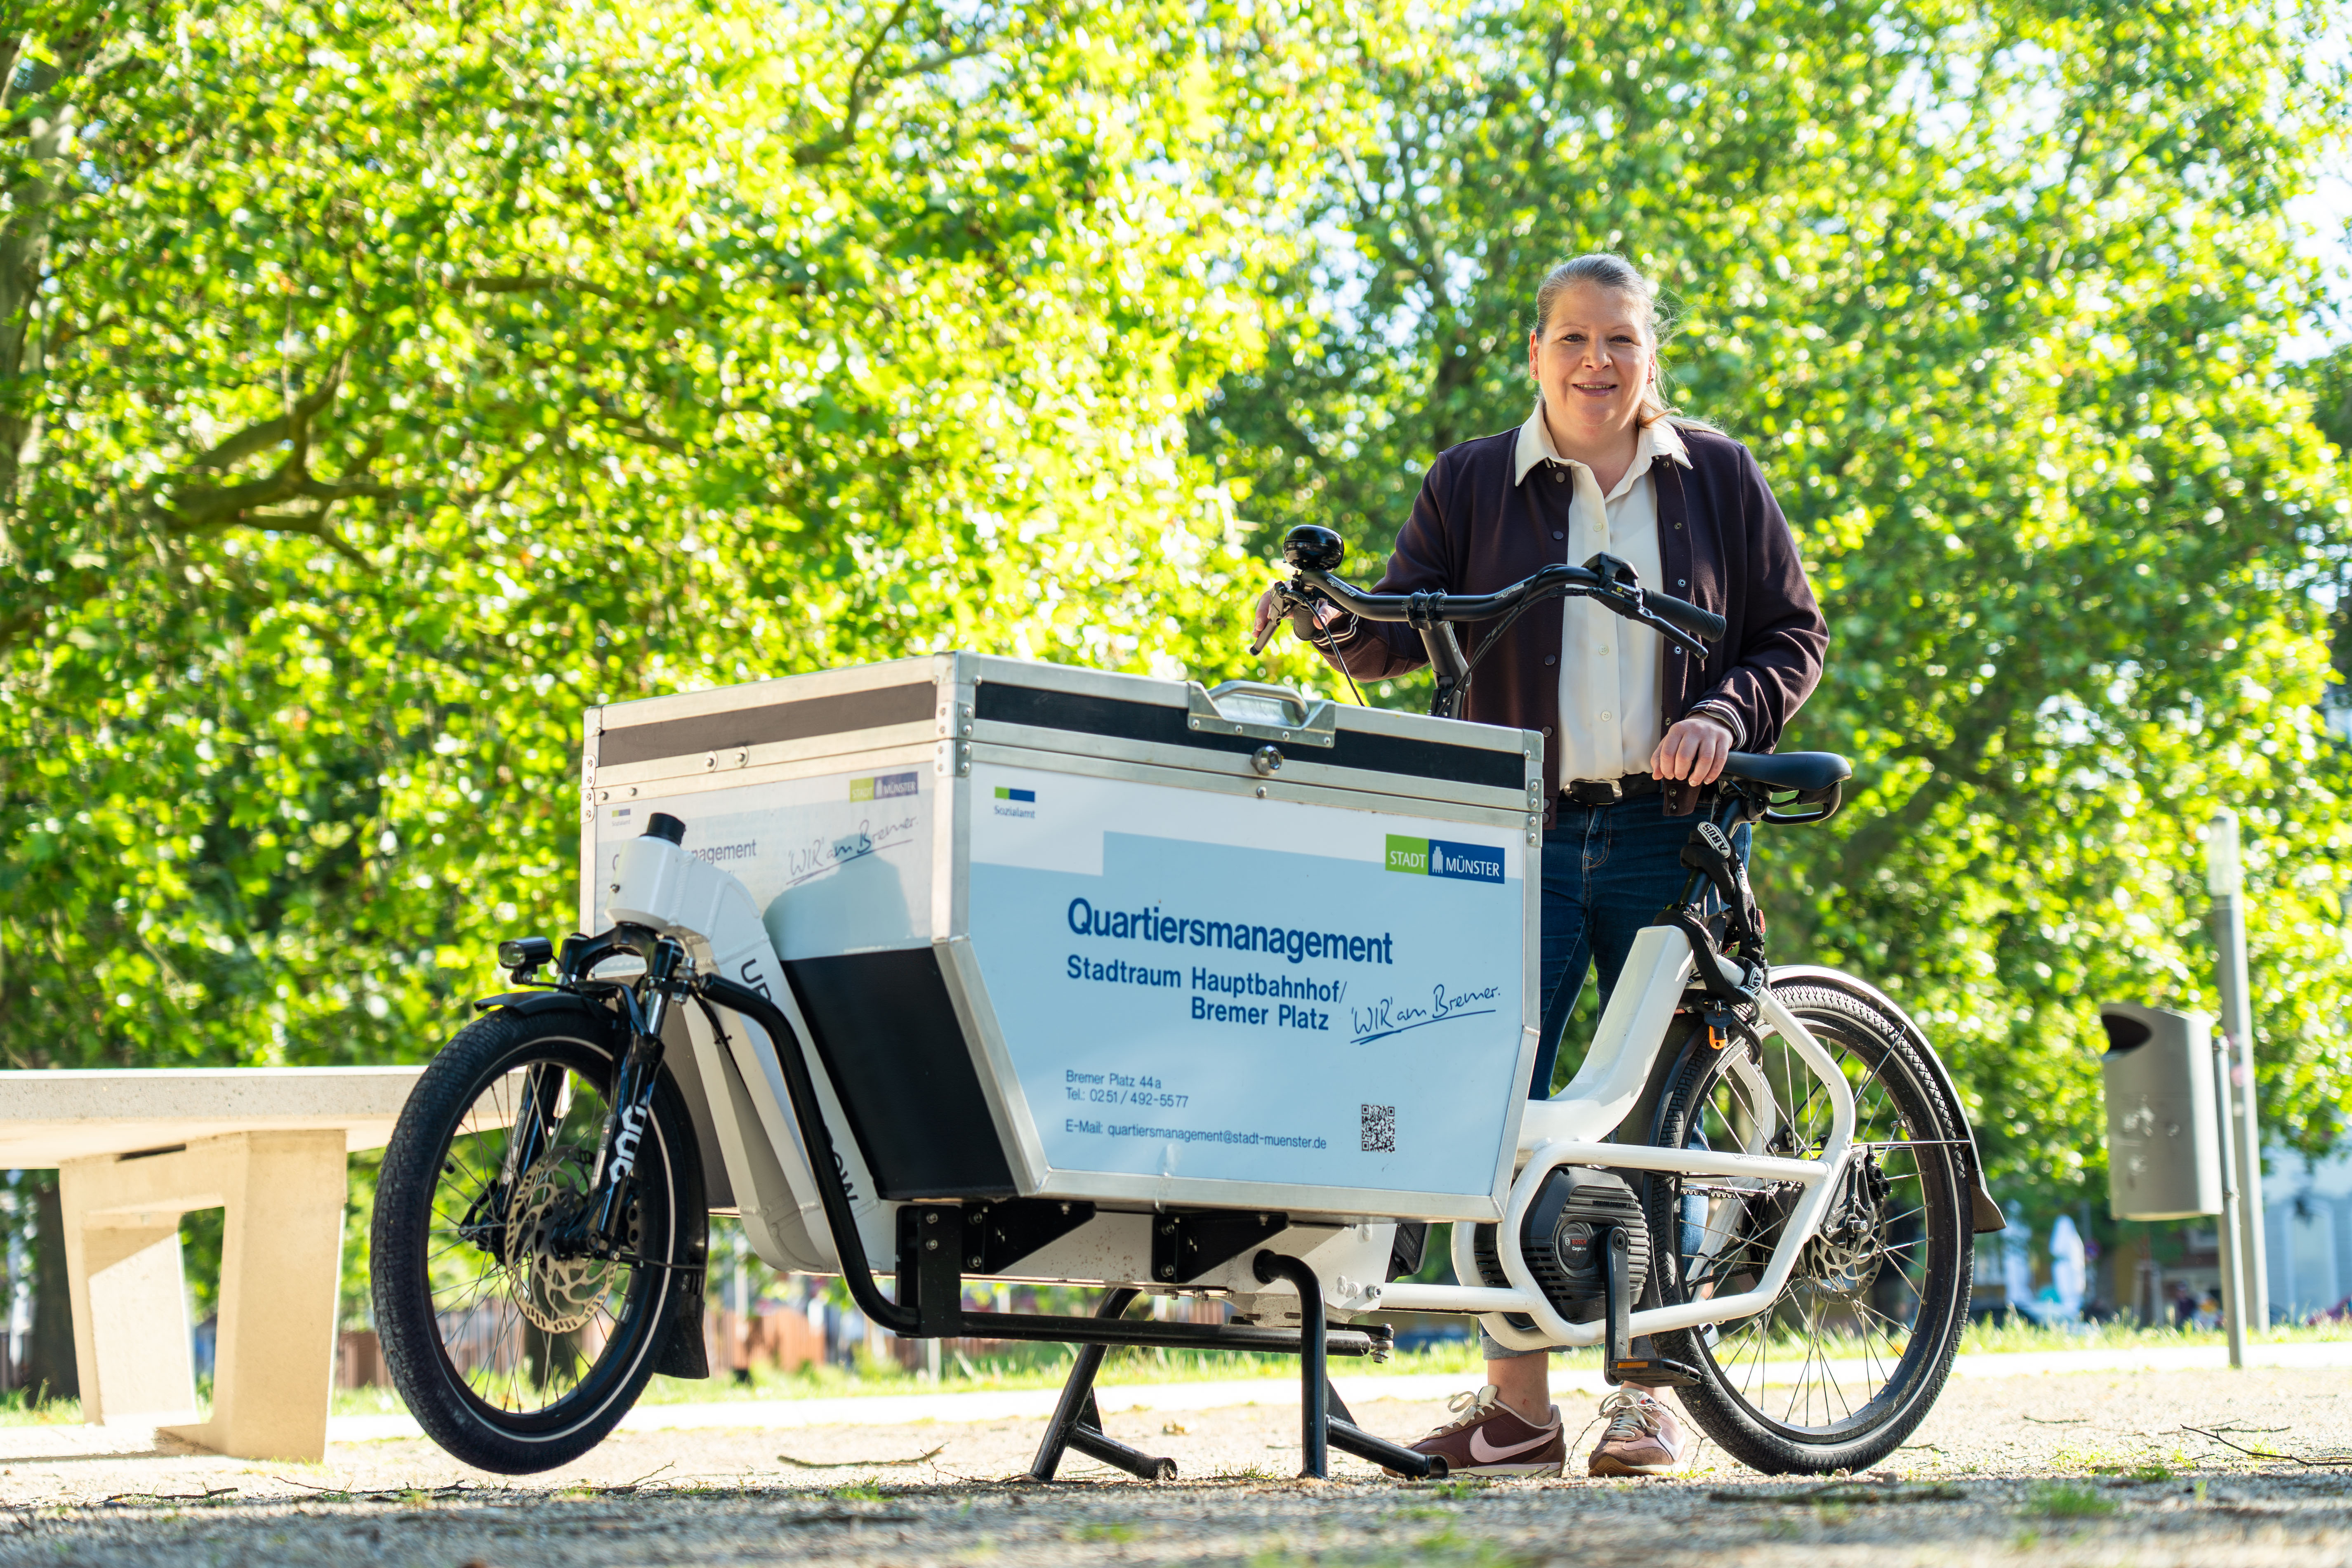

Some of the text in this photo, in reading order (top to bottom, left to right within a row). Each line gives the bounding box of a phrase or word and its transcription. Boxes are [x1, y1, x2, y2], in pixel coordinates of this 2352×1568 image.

[1327, 578, 1351, 594] ergotec
[1611, 590, 1625, 598] MAGURA
[851, 780, 917, 799] STADT MÜNSTER
[994, 805, 1036, 819] Sozialamt
[1702, 823, 1728, 852] ABUS
[827, 842, 853, 860] am
[1390, 851, 1500, 877] STADT MÜNSTER
[1068, 898, 1393, 965] Quartiersmanagement
[1067, 955, 1348, 1005] Stadtraum Hauptbahnhof/
[1744, 971, 1763, 991] ABU
[1191, 997, 1329, 1031] Bremer Platz
[1397, 1004, 1427, 1021] am
[1066, 1069, 1105, 1085] Bremer
[1110, 1073, 1135, 1087] Platz
[1066, 1087, 1085, 1101] Tel.:
[1065, 1118, 1327, 1150] E-Mail: quartiersmanagement@stadt-muenster.de
